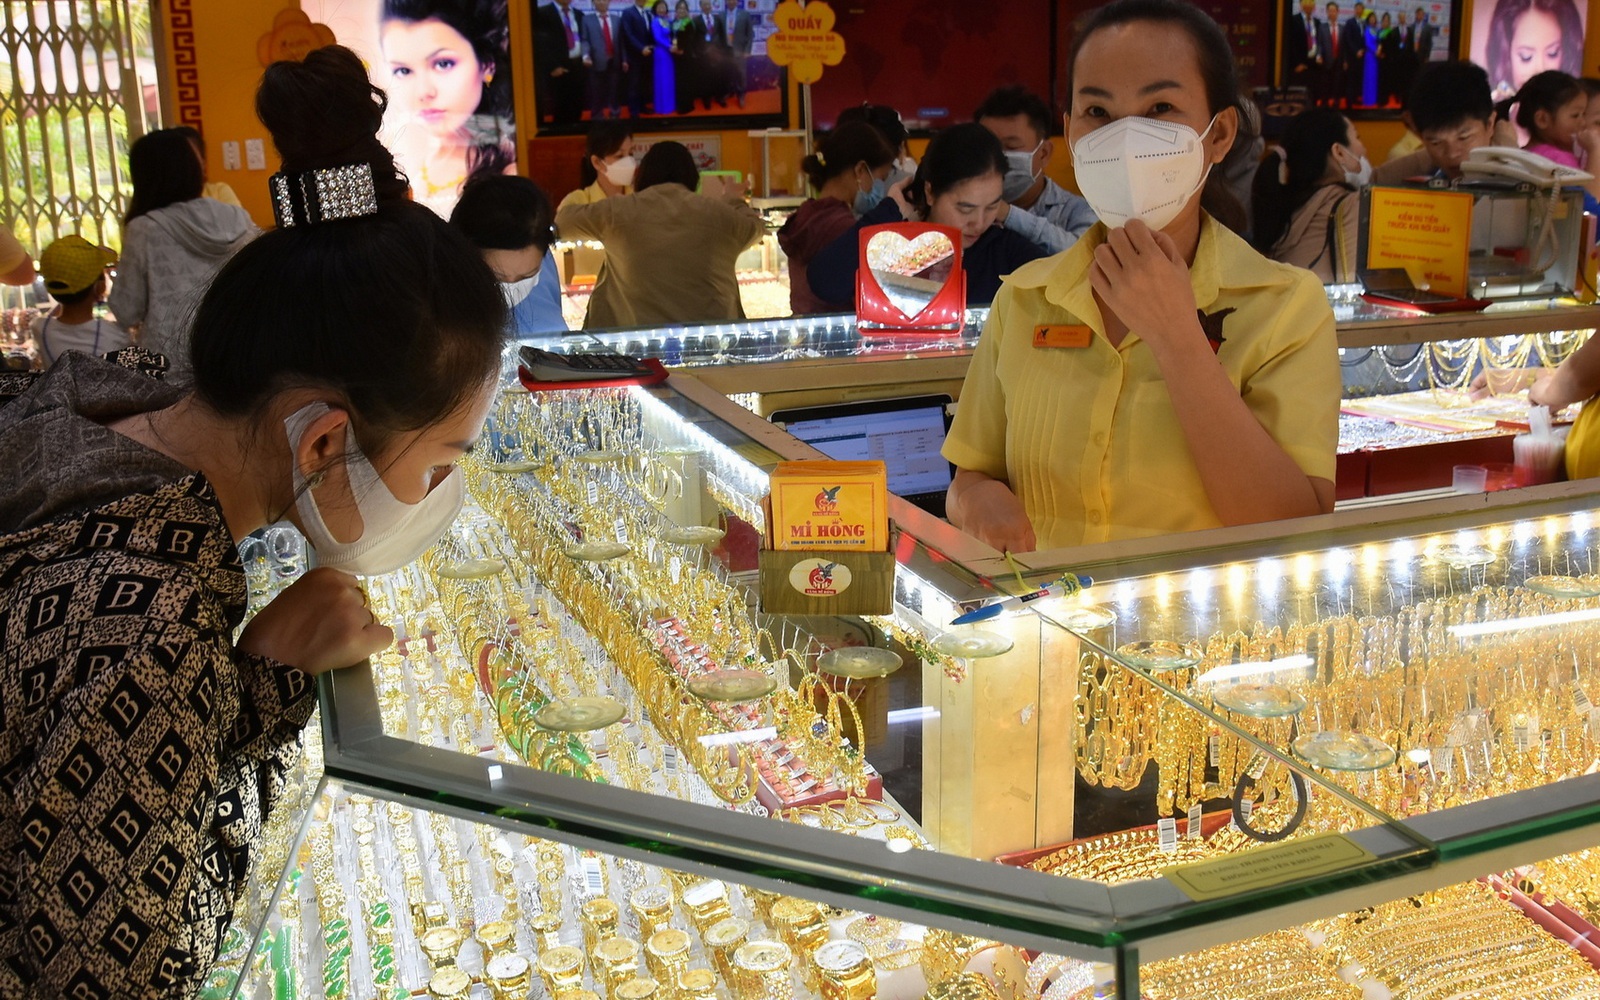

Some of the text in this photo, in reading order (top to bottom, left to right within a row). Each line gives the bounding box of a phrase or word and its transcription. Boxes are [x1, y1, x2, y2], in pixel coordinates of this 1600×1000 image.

[90, 522, 119, 548] B
[167, 529, 195, 554] B
[816, 517, 865, 538] HỒNG
[33, 595, 60, 630] B
[106, 581, 144, 609] B
[110, 690, 140, 731] B
[65, 752, 94, 790] B
[156, 744, 183, 783] B
[23, 818, 51, 852] B
[110, 809, 140, 848] B
[67, 869, 95, 909] B
[151, 854, 177, 890] B
[30, 924, 53, 959] B
[110, 921, 140, 958] B
